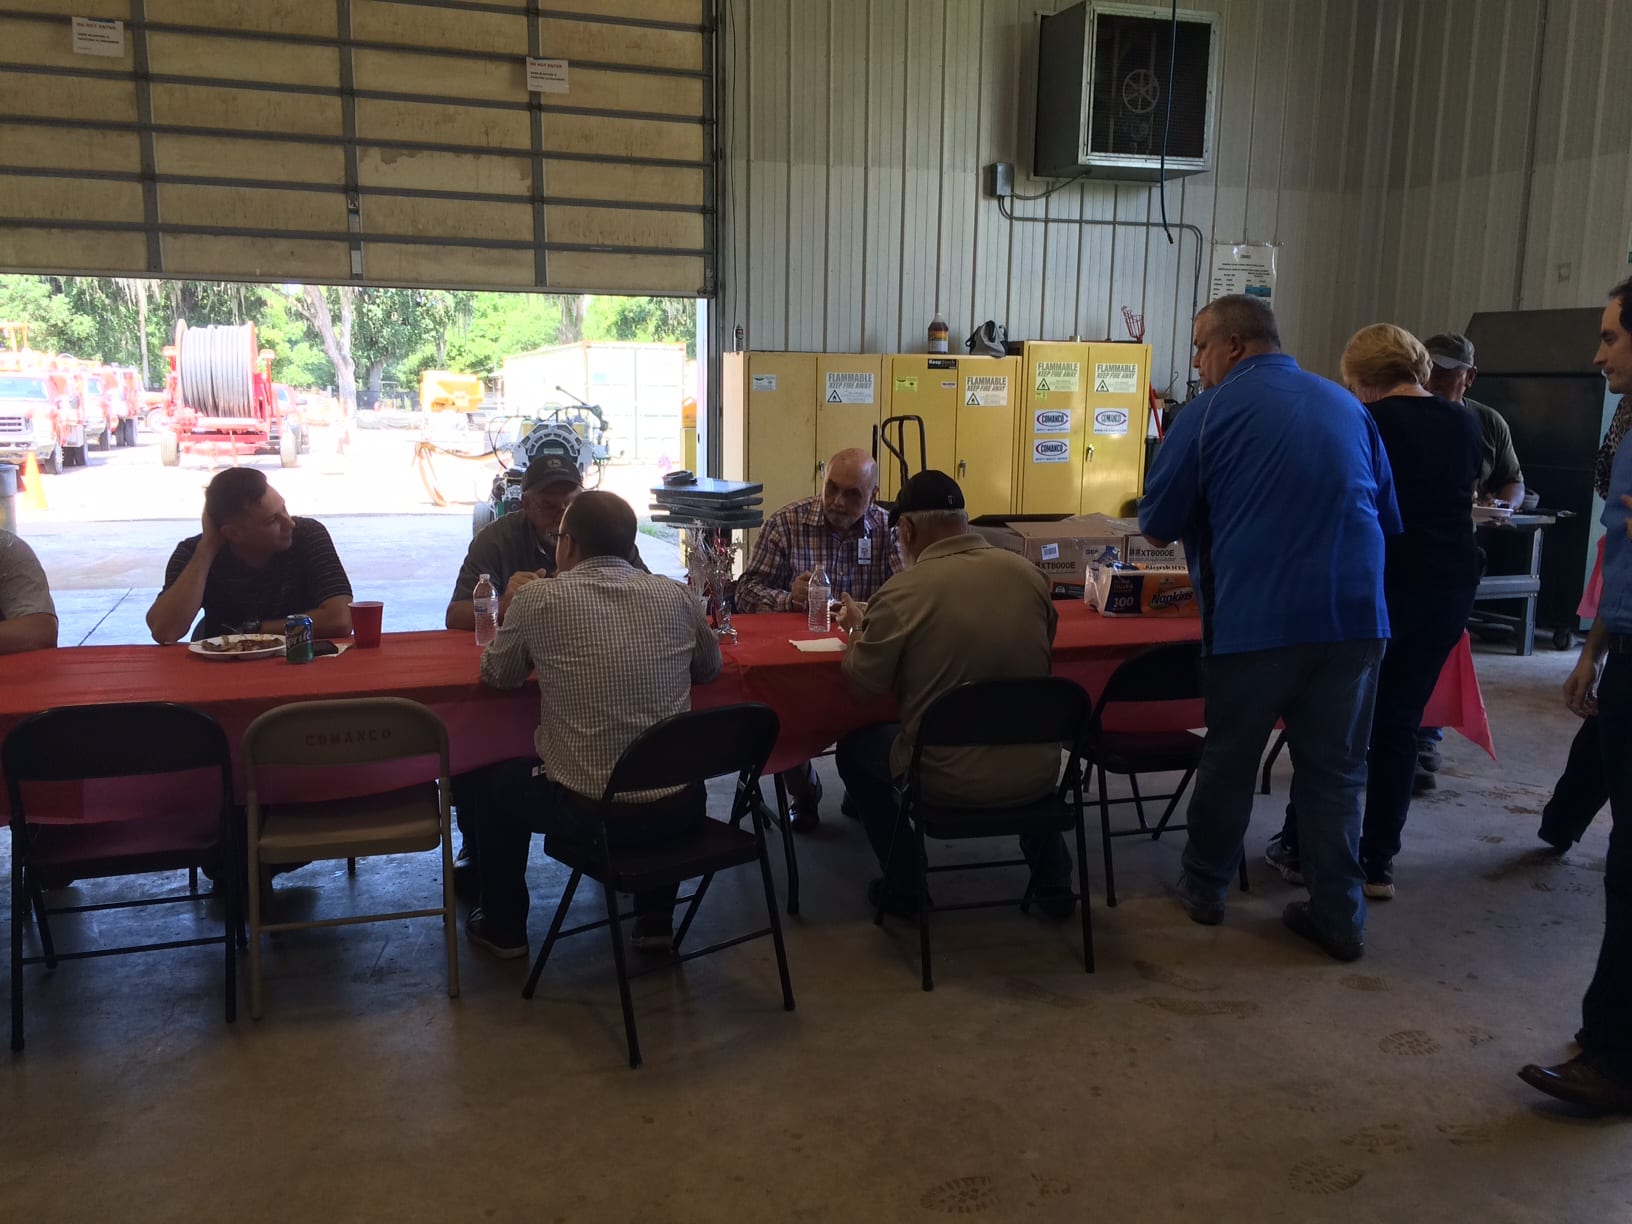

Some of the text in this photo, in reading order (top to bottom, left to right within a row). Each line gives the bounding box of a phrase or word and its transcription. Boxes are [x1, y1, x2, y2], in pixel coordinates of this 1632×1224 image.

[1038, 362, 1078, 371] FLAMMABLE
[1097, 364, 1136, 373] FLAMMABLE
[828, 373, 872, 382] FLAMMABLE
[967, 377, 1006, 386] FLAMMABLE
[1041, 414, 1064, 424] COMANCO
[1040, 443, 1063, 453] COMANCO
[1113, 597, 1134, 608] 300
[1152, 590, 1193, 605] Napkins
[305, 728, 391, 746] COMANCO
